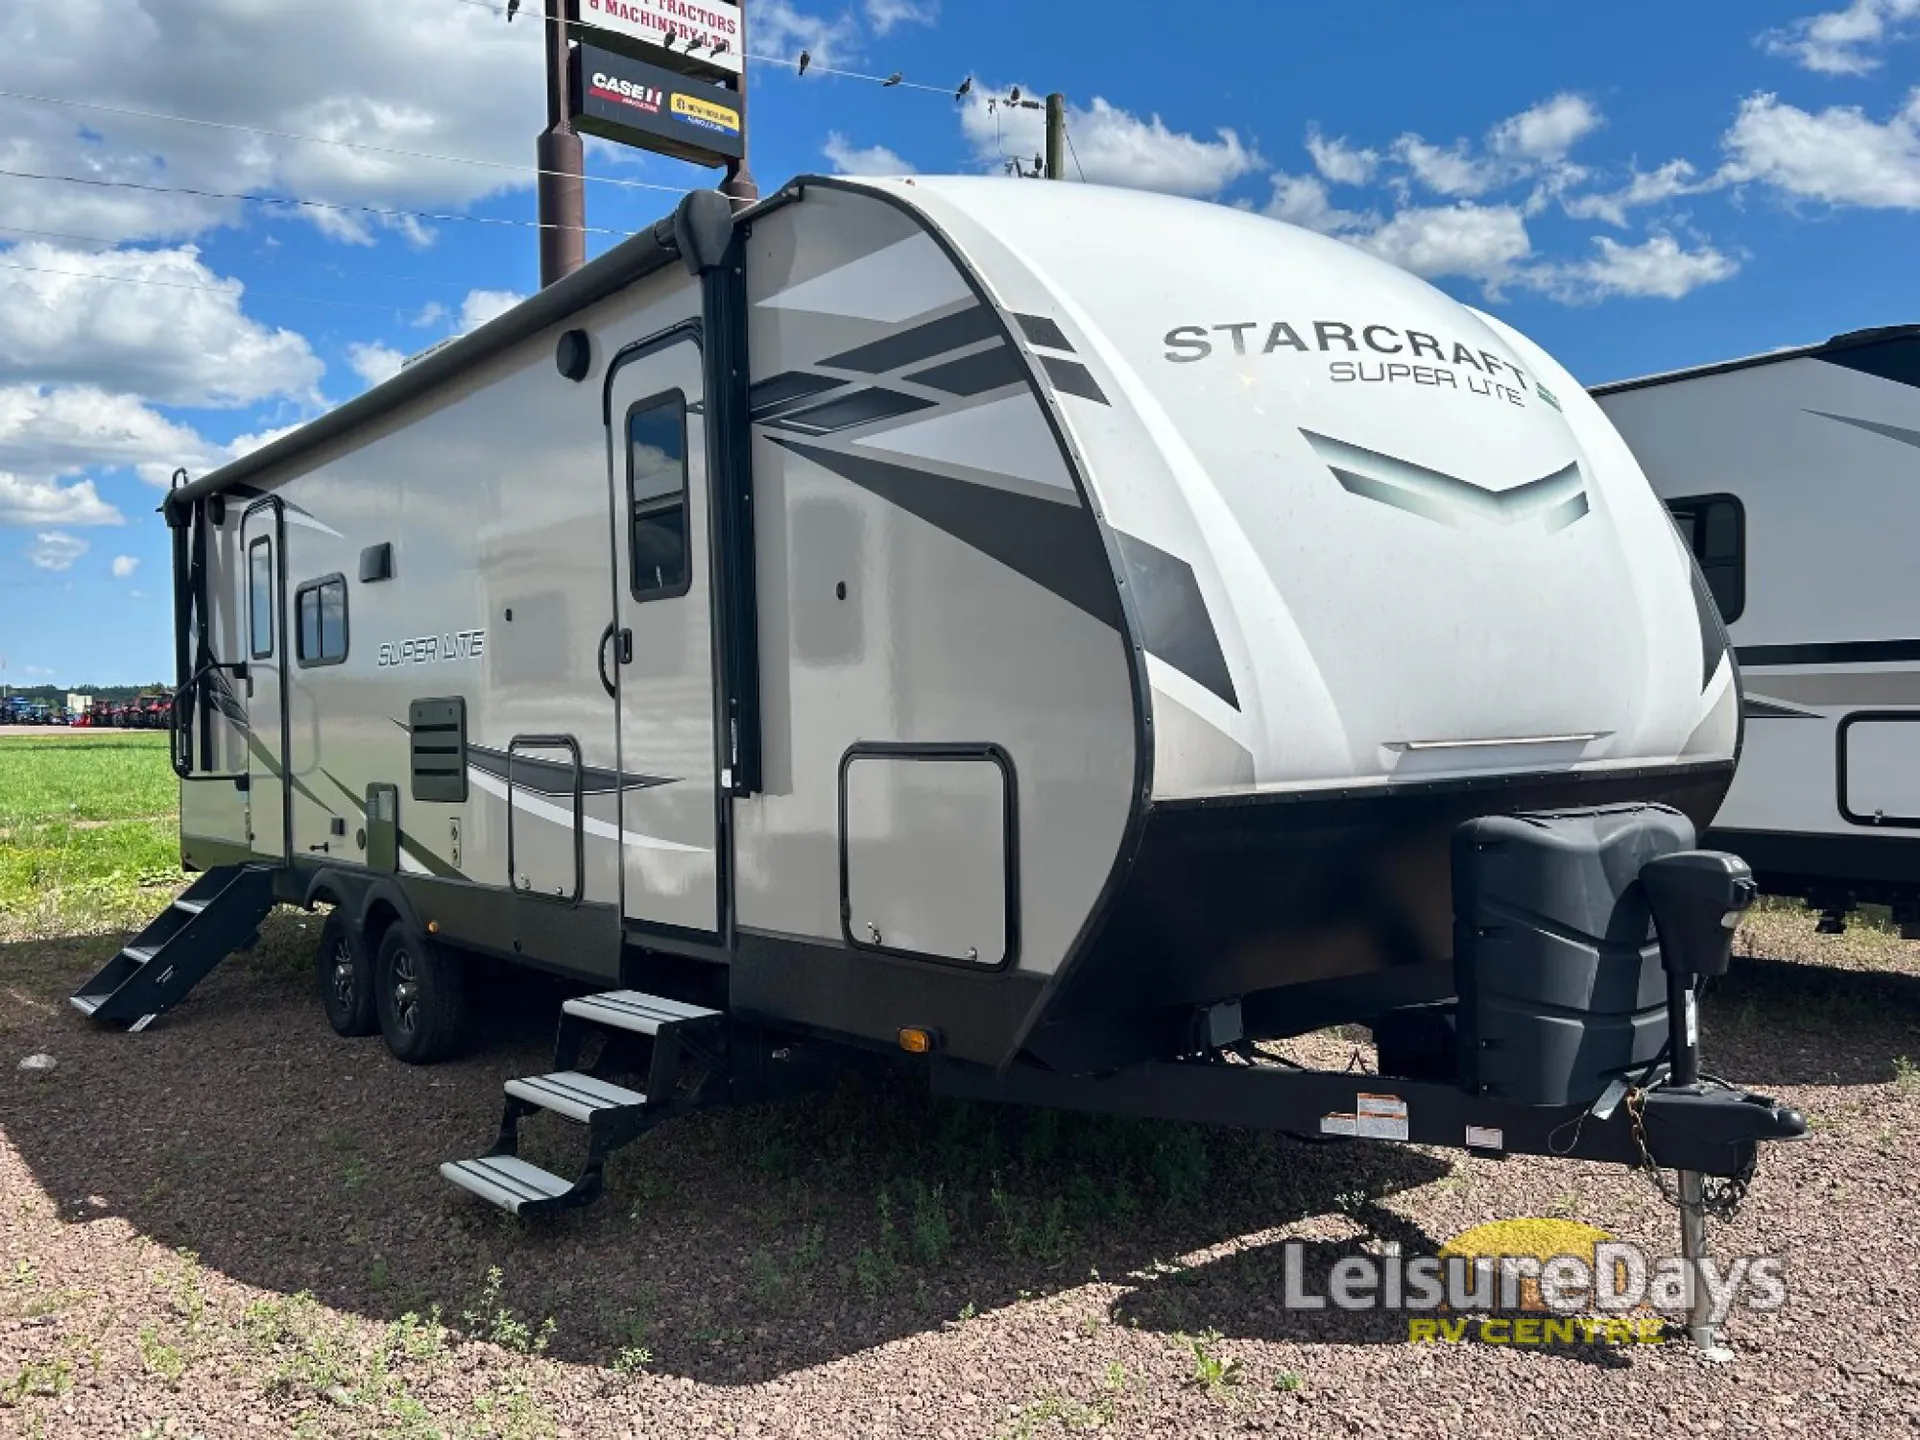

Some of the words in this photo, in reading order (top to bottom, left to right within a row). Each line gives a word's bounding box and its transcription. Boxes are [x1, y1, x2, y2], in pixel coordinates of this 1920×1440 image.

[658, 0, 736, 34] TRACTORS
[592, 72, 645, 100] CASE
[1163, 320, 1528, 390] STARCRAFT
[1329, 361, 1458, 388] SUPER
[1467, 375, 1526, 408] LITE
[377, 636, 438, 668] SUPER
[442, 629, 485, 660] LITE
